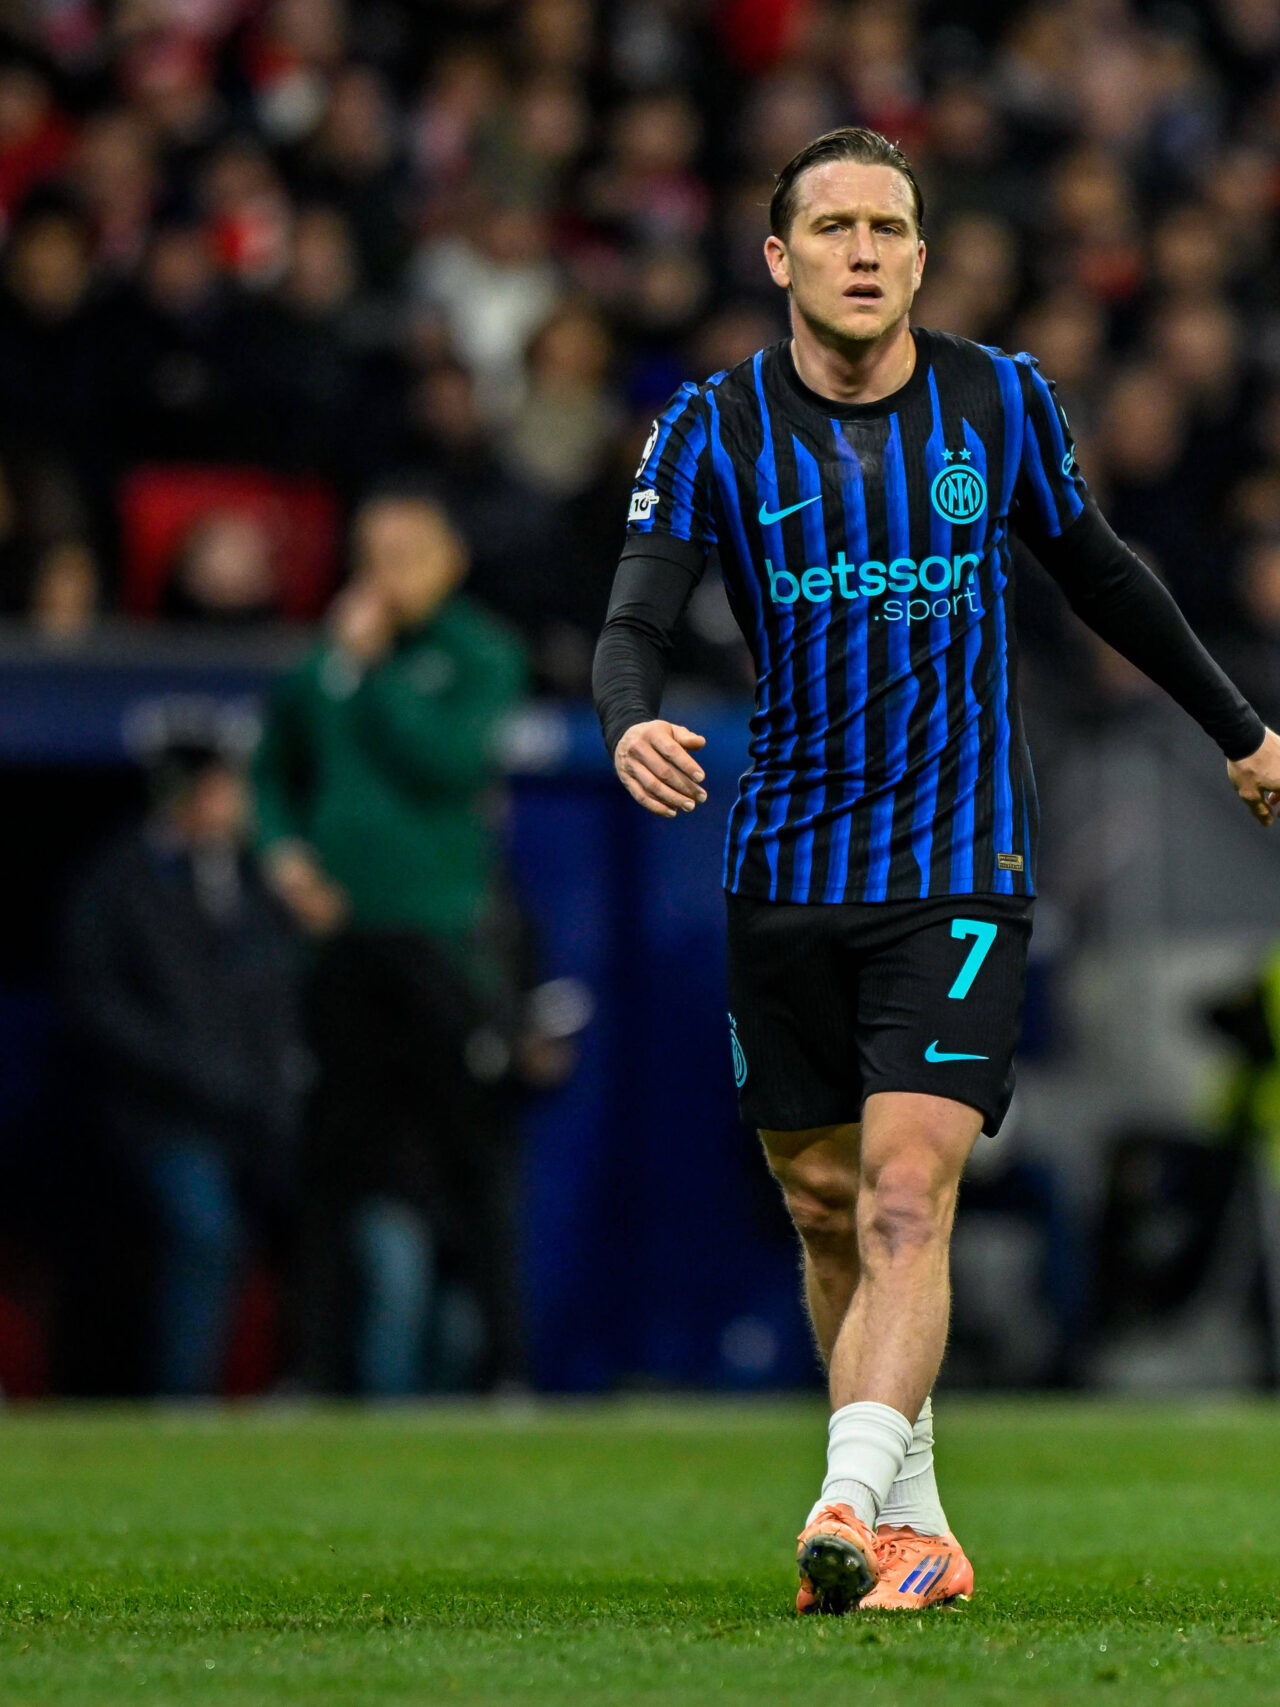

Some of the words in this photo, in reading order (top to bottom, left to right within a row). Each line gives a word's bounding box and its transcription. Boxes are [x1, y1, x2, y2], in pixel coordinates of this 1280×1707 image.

[765, 551, 981, 604] betsson
[874, 587, 979, 627] .sport
[947, 918, 998, 1000] 7
